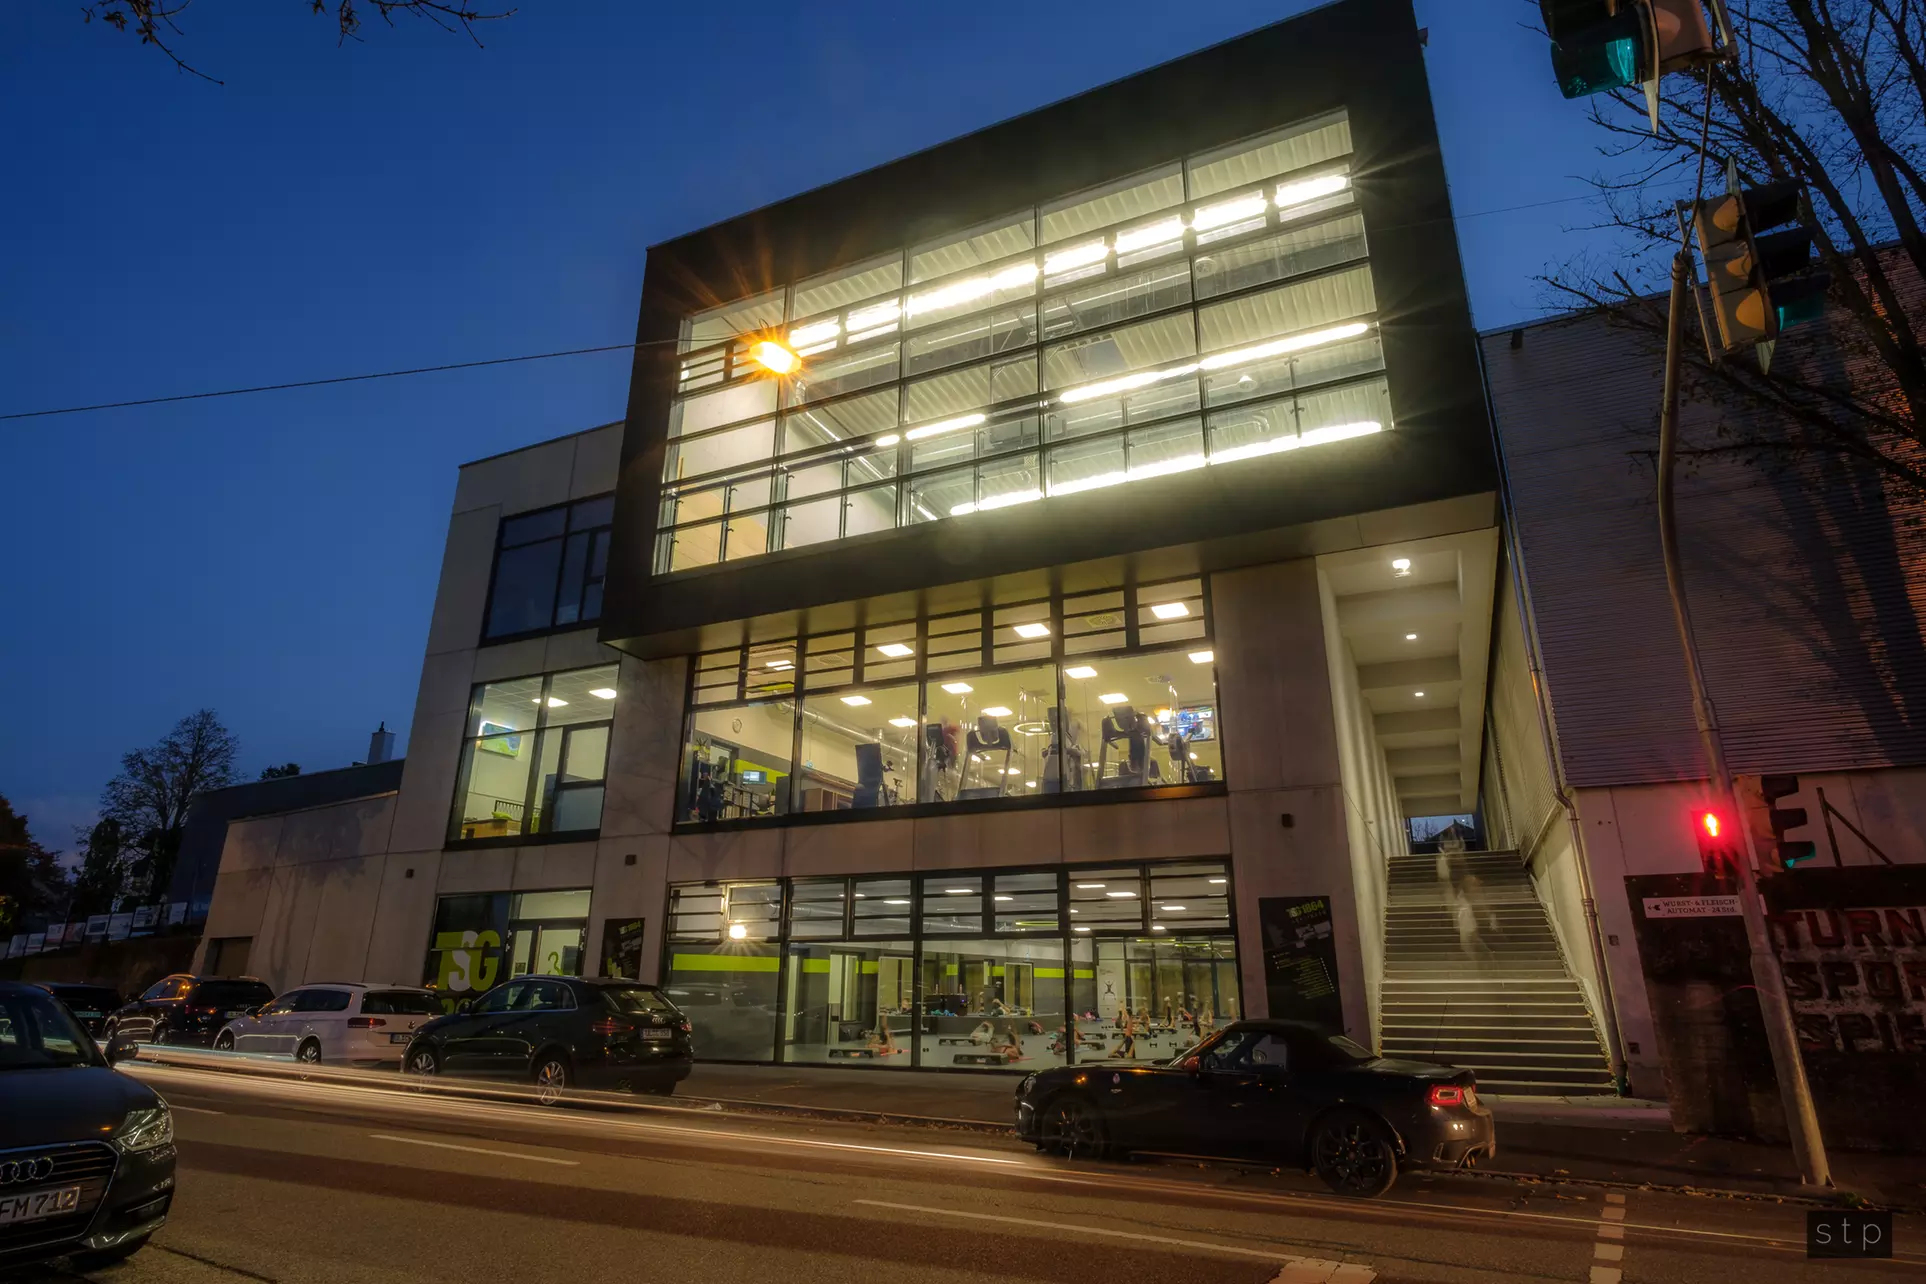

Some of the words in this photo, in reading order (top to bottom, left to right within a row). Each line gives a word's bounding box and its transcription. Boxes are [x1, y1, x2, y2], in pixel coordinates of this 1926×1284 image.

[1667, 906, 1706, 914] AUTOMAT
[1711, 906, 1721, 914] 24
[436, 929, 501, 992] TSG
